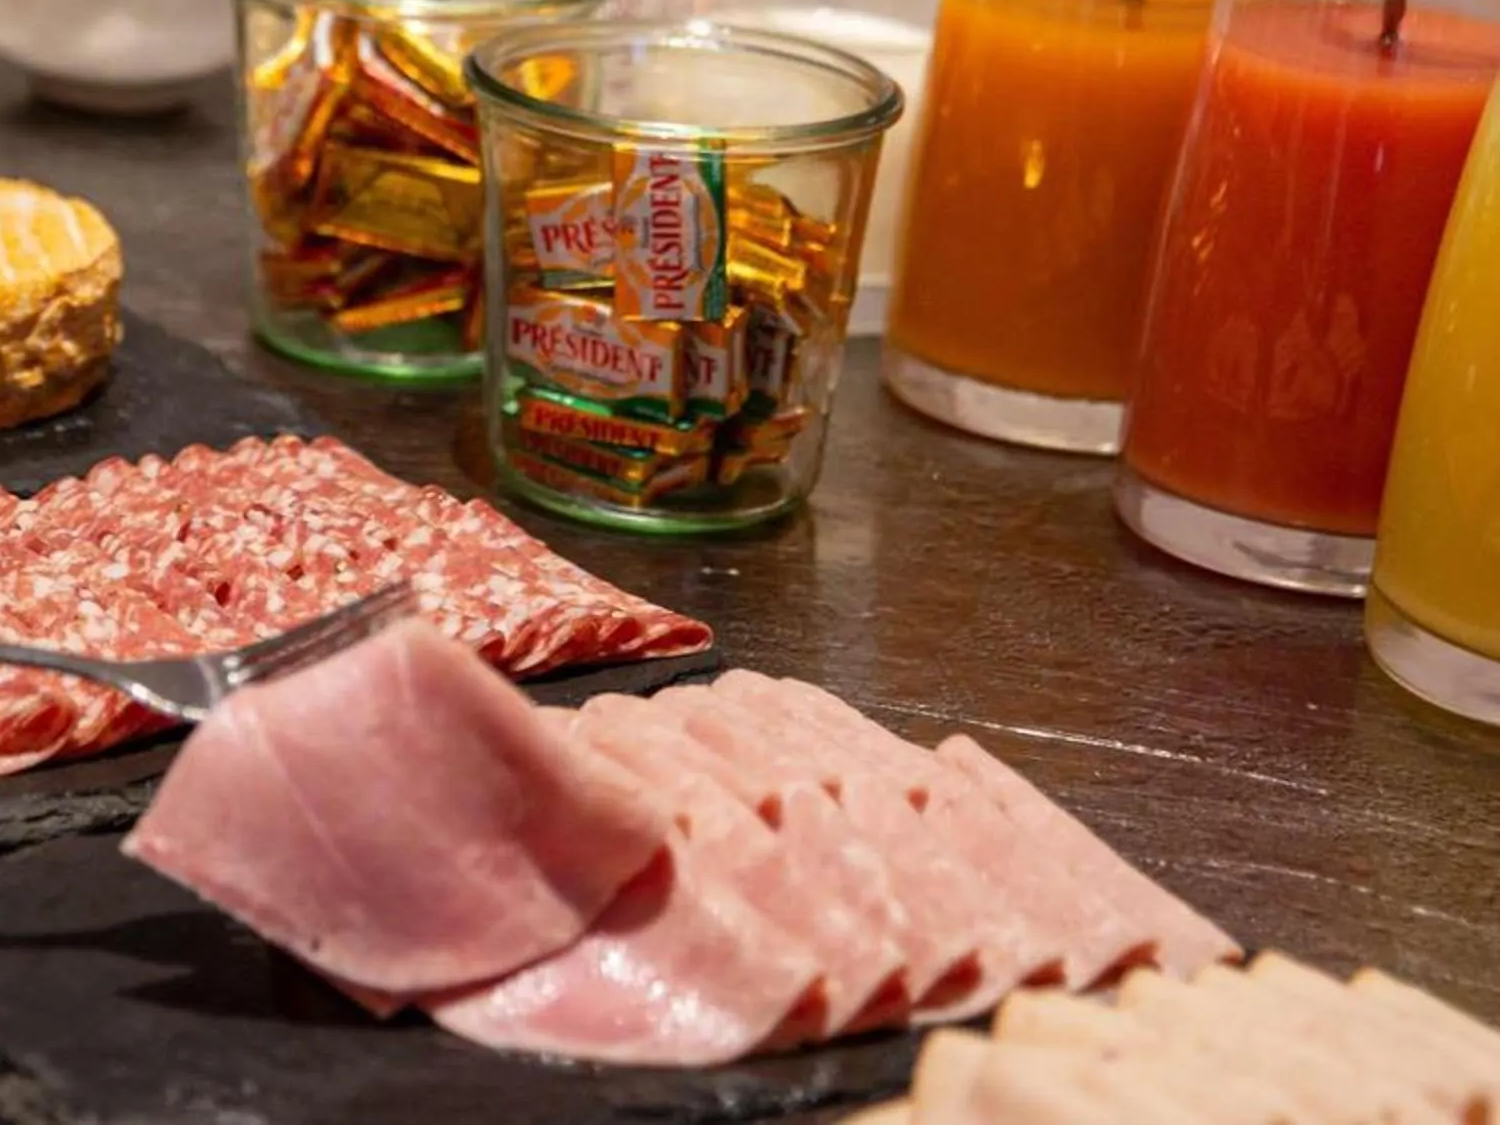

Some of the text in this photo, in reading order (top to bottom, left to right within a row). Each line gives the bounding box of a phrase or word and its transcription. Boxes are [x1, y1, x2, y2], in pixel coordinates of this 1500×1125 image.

[540, 213, 617, 253] PRÉS
[649, 153, 688, 311] PRÉSIDENT
[511, 318, 663, 382] PRÉSIDENT
